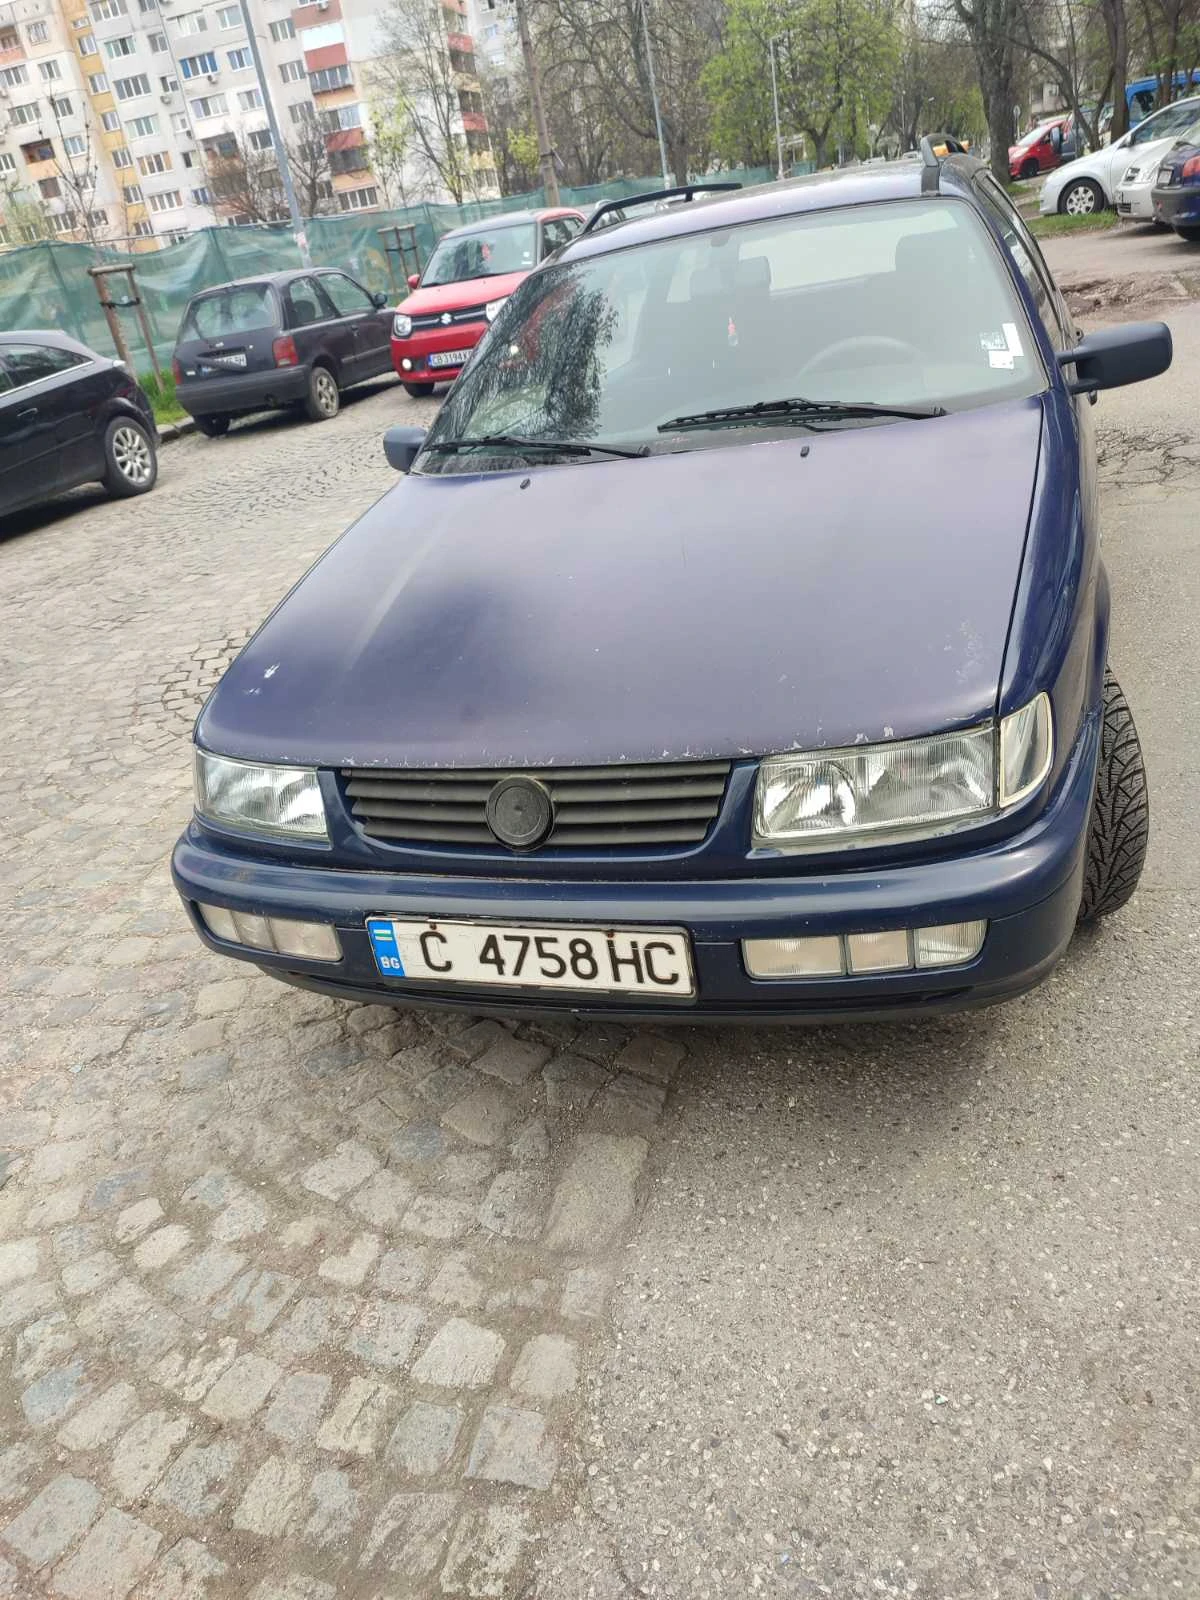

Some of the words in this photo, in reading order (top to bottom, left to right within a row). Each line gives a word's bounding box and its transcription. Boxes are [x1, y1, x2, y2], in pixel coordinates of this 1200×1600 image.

[380, 957, 400, 969] BG
[419, 931, 453, 972] C
[479, 934, 599, 980] 4758
[606, 938, 680, 985] HC
